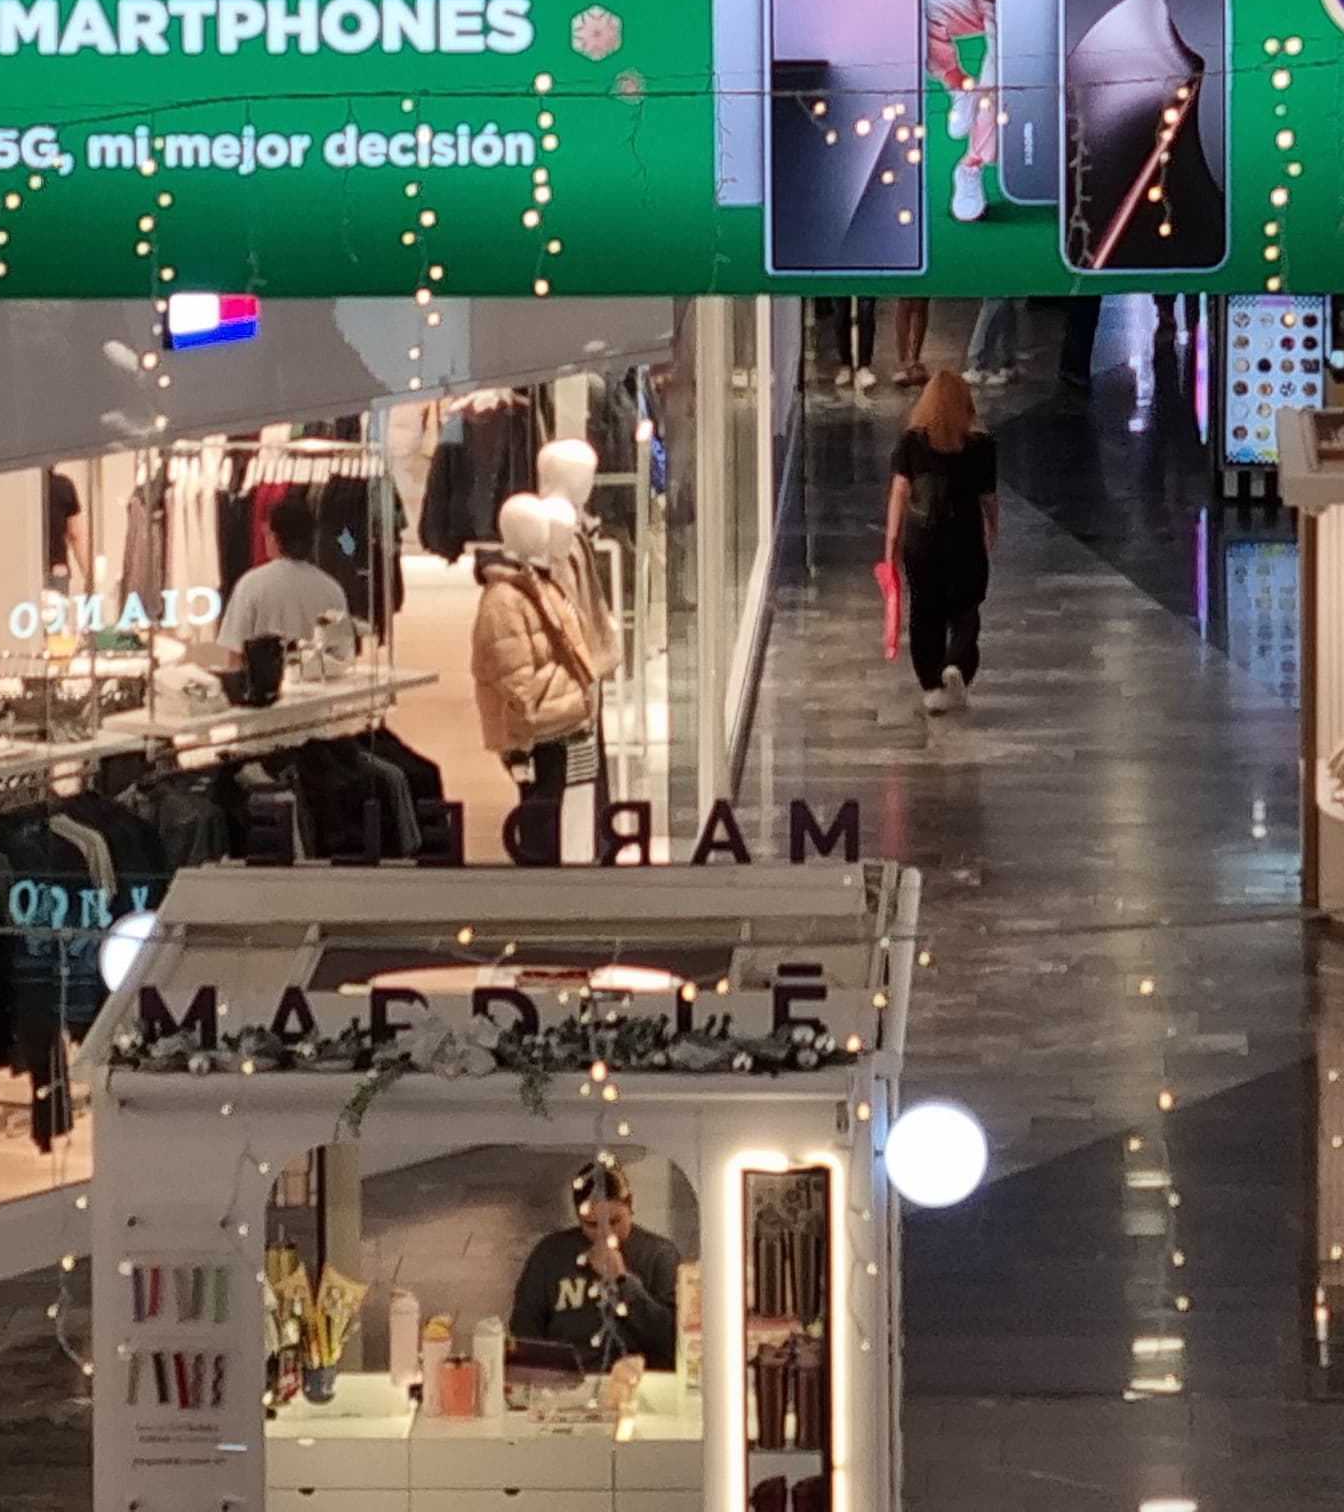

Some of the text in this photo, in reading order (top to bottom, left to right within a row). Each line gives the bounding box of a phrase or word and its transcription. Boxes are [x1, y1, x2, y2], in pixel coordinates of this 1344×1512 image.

[87, 125, 150, 171] mi
[162, 123, 313, 176] mejor
[323, 121, 537, 170] decisión
